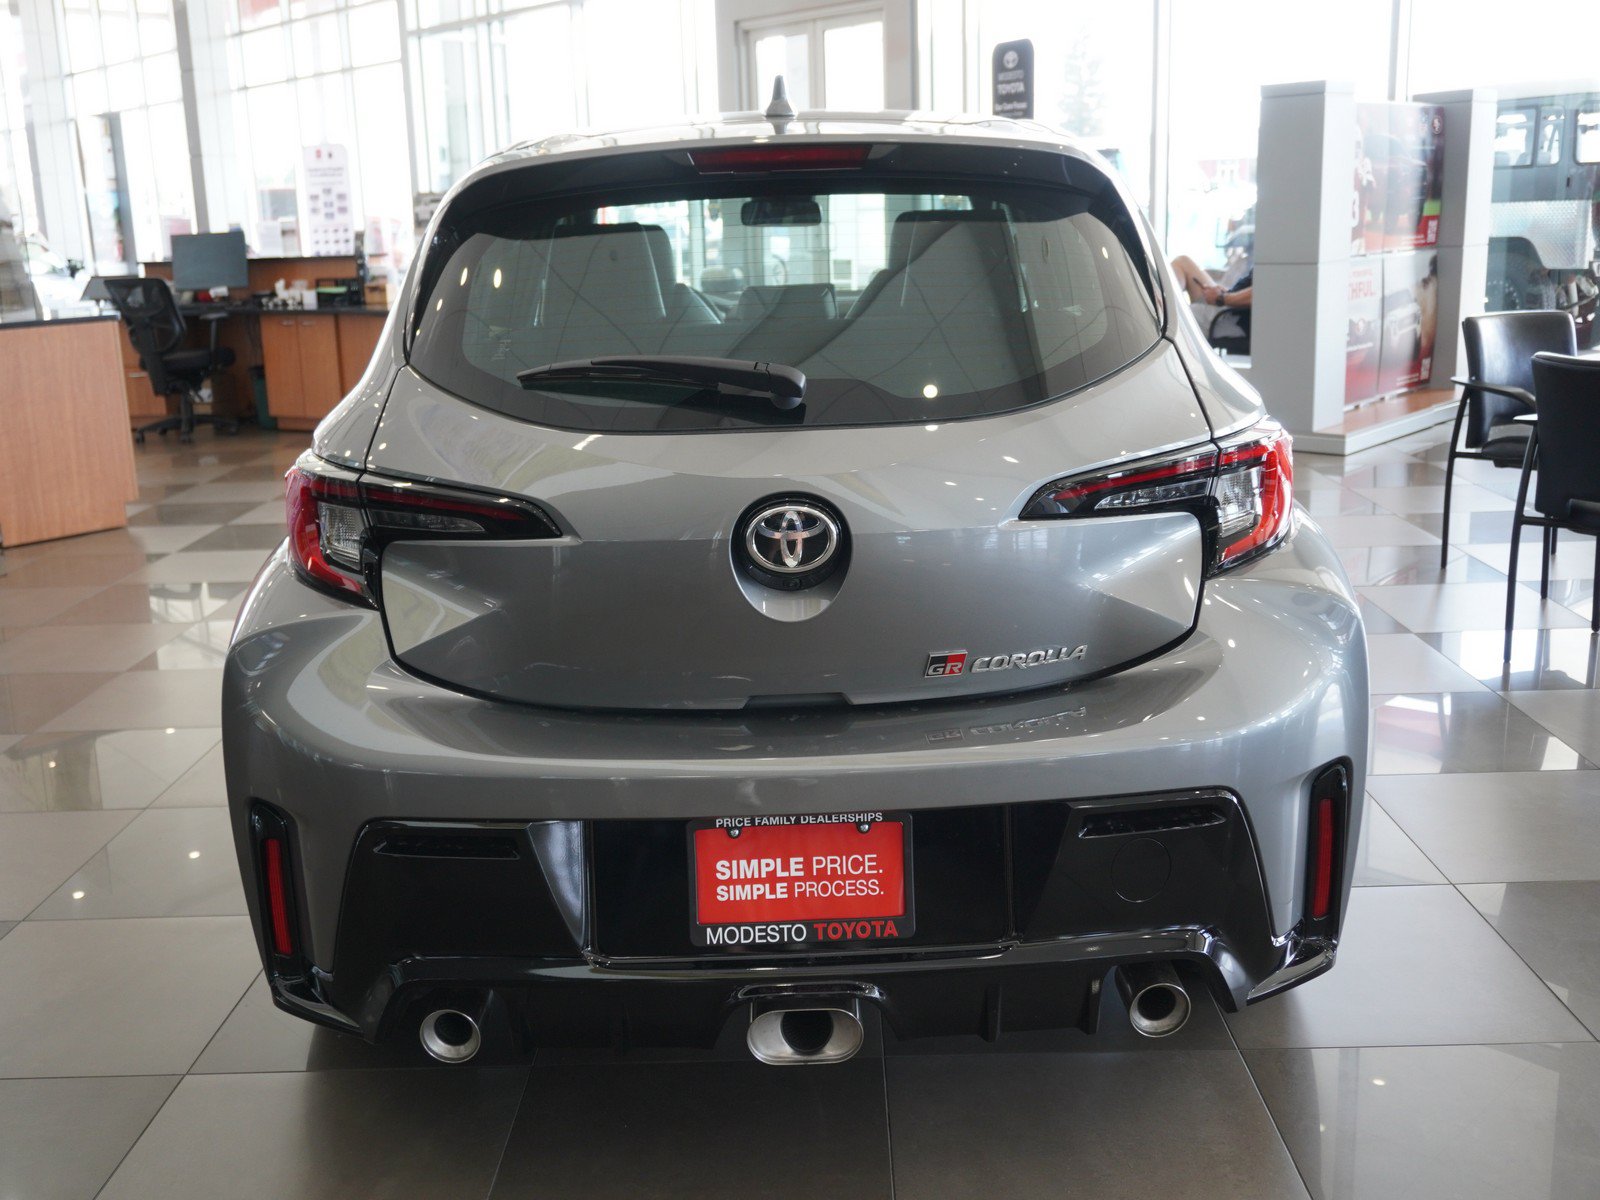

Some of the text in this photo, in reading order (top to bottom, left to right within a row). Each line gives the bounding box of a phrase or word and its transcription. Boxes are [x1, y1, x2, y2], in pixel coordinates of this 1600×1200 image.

[997, 81, 1025, 94] TOYOTA
[970, 644, 1088, 674] COROLLA
[715, 812, 883, 828] PRICE FAMILY DEALERSHIPS
[715, 854, 883, 880] SIMPLE PRICE.
[716, 879, 884, 901] SIMPLE PROCESS.
[706, 920, 899, 945] MODESTO TOYOTA
